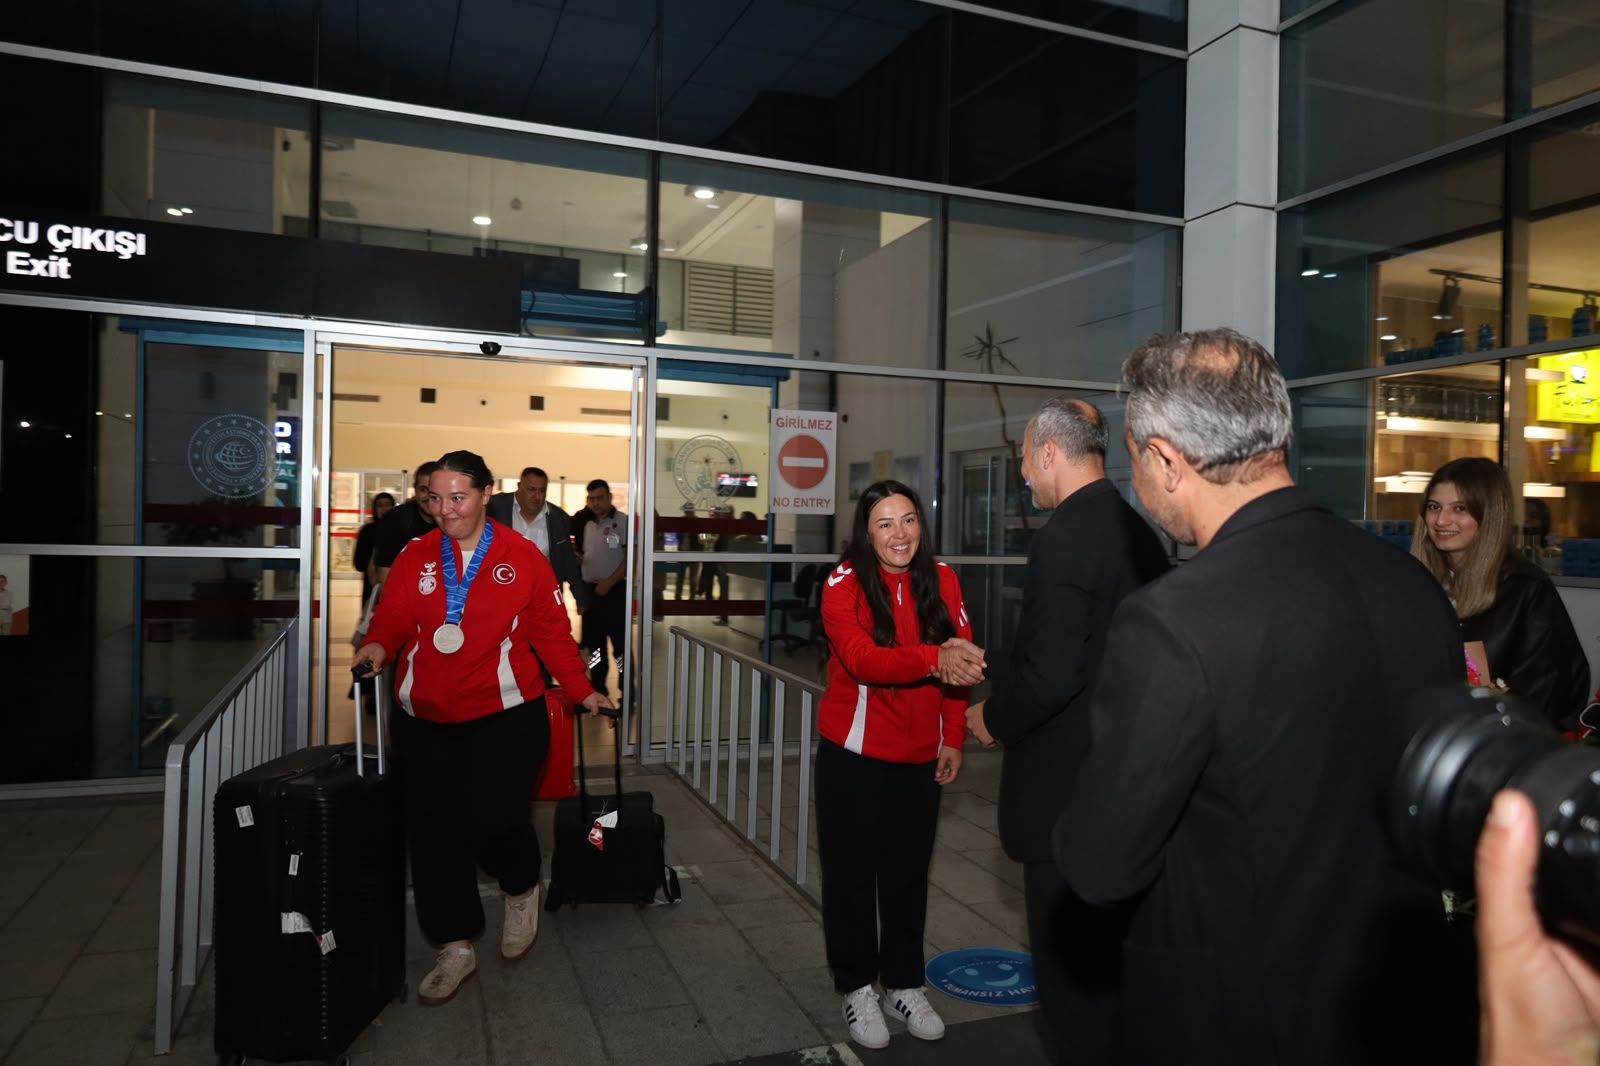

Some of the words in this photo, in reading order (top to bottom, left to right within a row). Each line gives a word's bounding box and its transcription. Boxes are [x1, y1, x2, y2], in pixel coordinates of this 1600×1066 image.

[47, 223, 146, 259] ÇIKIŞI
[6, 250, 72, 279] Exit
[775, 415, 833, 431] GİRİLMEZ
[773, 496, 790, 507] NO
[793, 497, 832, 509] ENTRY
